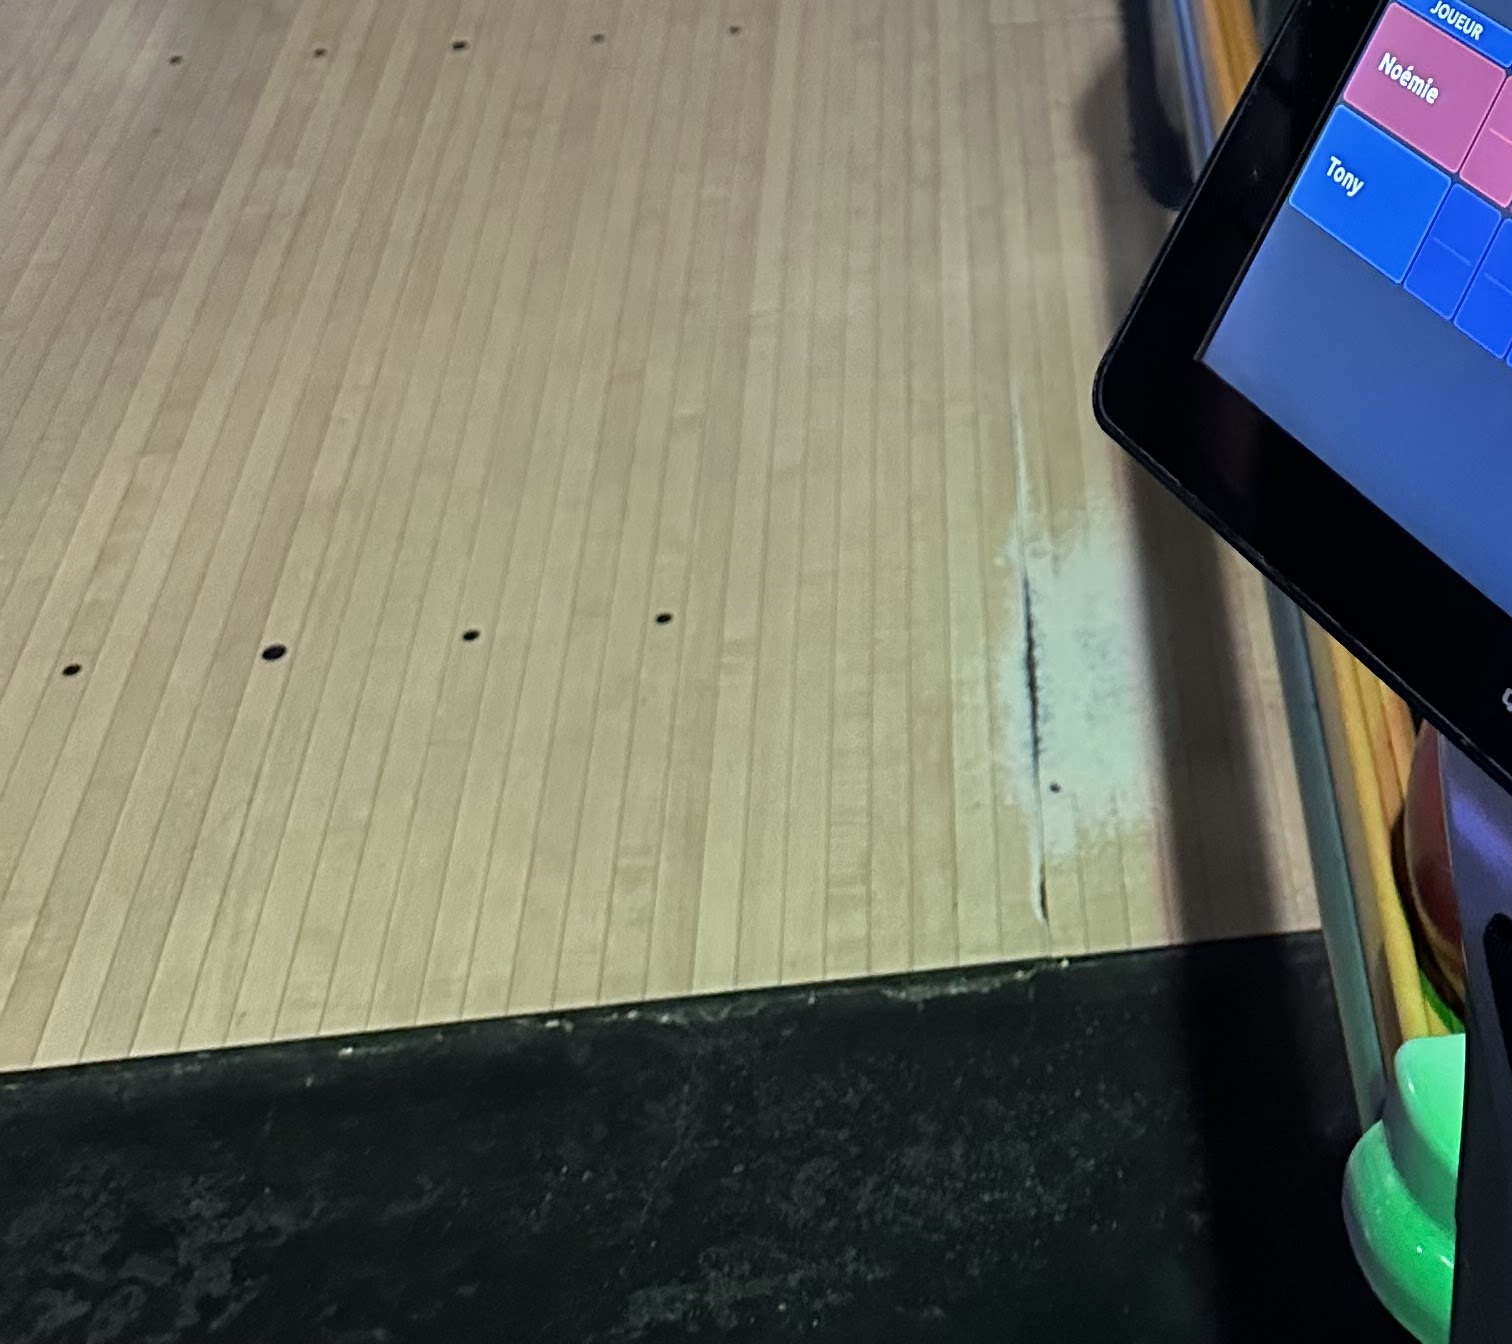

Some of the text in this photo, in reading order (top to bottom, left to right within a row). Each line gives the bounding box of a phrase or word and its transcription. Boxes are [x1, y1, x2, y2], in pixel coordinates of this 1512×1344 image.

[1429, 0, 1484, 41] JOUEUR
[1377, 52, 1439, 105] Noémie
[1325, 155, 1365, 197] Tony
